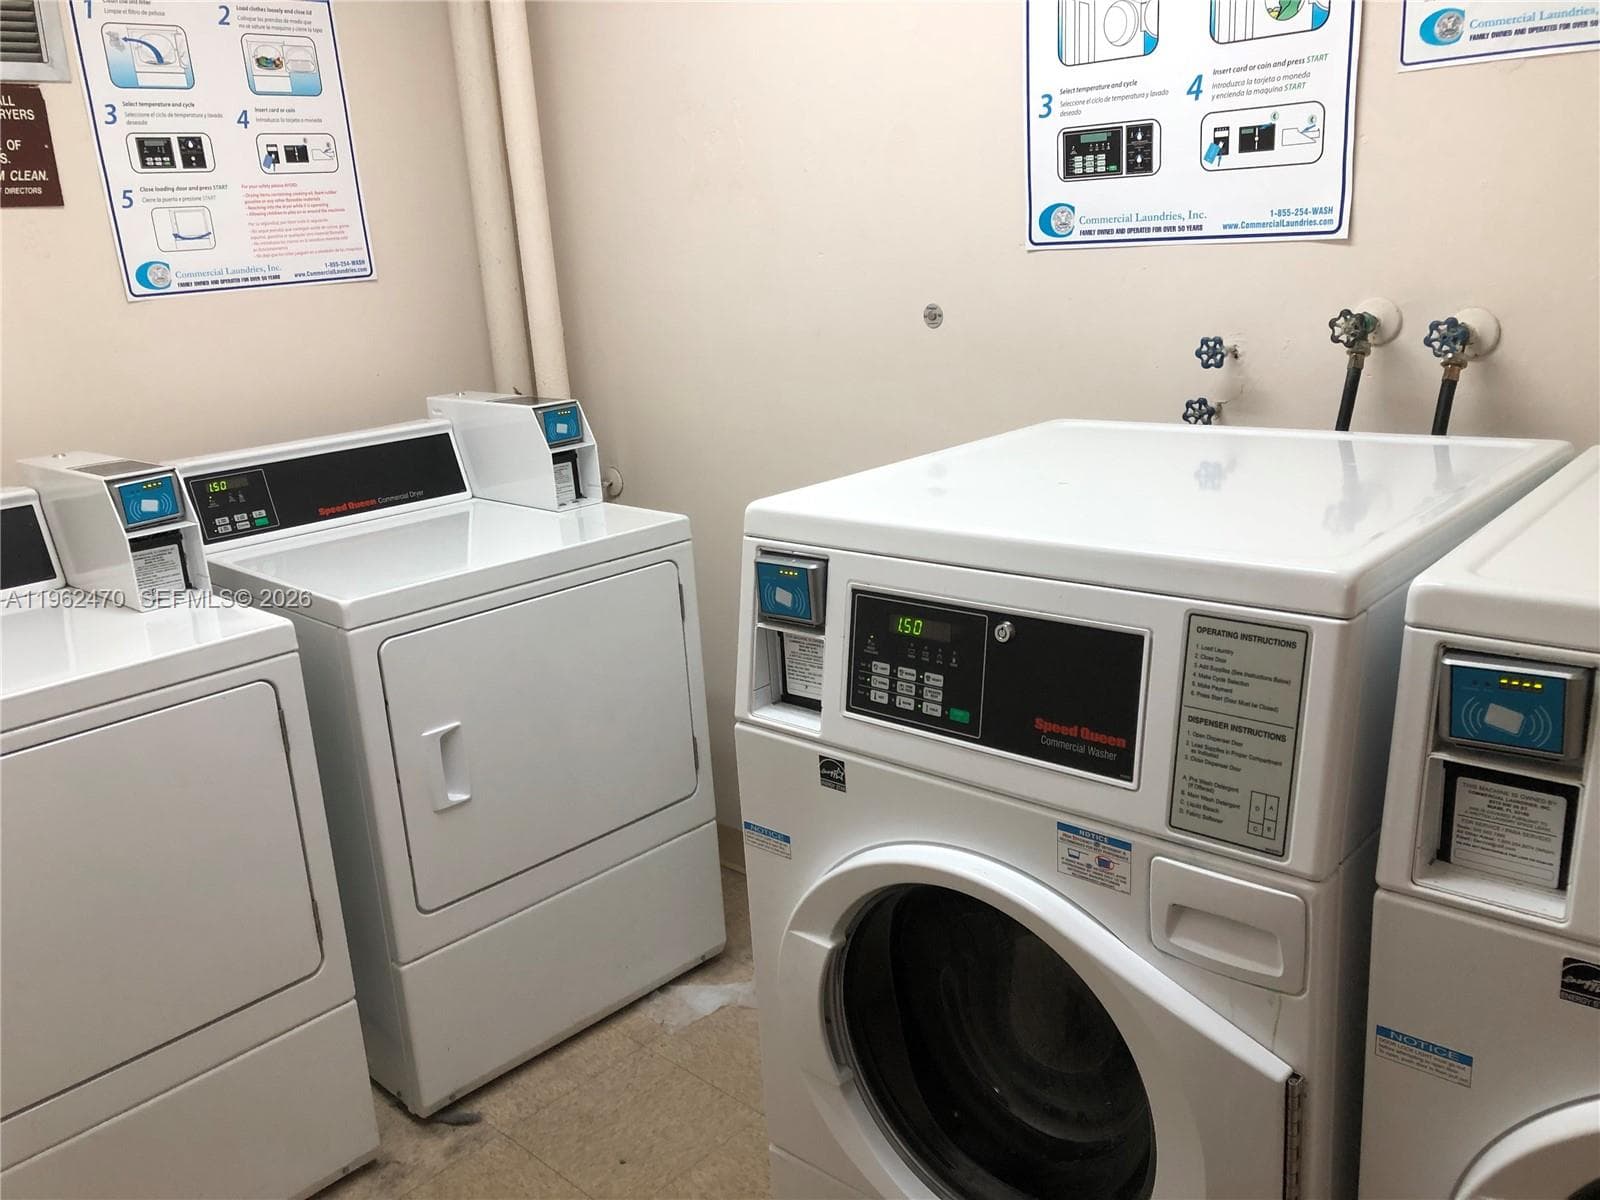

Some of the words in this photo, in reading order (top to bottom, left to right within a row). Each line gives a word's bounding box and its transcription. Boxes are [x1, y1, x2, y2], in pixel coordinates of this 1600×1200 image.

[84, 0, 92, 18] 1
[218, 5, 230, 25] 2
[1470, 12, 1535, 28] Commercial
[1540, 6, 1599, 20] Laundries,
[1470, 32, 1490, 41] FAMILY
[1492, 29, 1512, 38] OWNED
[1514, 28, 1526, 36] AND
[1528, 24, 1557, 34] OPERATED
[1559, 23, 1570, 31] FOR
[1572, 21, 1588, 29] OVER
[1213, 66, 1231, 76] Insert
[1233, 64, 1248, 73] card
[1257, 61, 1272, 70] coin
[1273, 59, 1286, 68] and
[1287, 58, 1305, 68] press
[1306, 53, 1328, 63] START
[1060, 87, 1075, 95] Select
[1076, 84, 1110, 94] temperature
[1111, 81, 1122, 89] and
[1123, 80, 1137, 89] cycle
[1186, 74, 1203, 100] 4
[1212, 80, 1245, 90] Introduzca
[1254, 75, 1275, 85] tarjeta
[1282, 71, 1310, 81] moneda
[1216, 88, 1244, 98] encienda
[1246, 87, 1252, 95] la
[1254, 85, 1283, 95] maquina
[1284, 81, 1306, 91] START
[139, 101, 170, 109] temperature
[1038, 94, 1053, 118] 3
[1060, 99, 1084, 107] Seleccione
[1092, 96, 1103, 104] ciclo
[1112, 92, 1145, 102] temperatura
[1150, 89, 1169, 97] lavado
[104, 104, 117, 124] 3
[236, 110, 250, 128] 4
[1060, 108, 1082, 117] deseado
[6, 140, 21, 150] OF
[10, 170, 48, 180] CLEAN.
[122, 190, 133, 208] 5
[1079, 214, 1132, 225] Commercial
[1136, 211, 1185, 222] Laundries,
[1188, 210, 1207, 219] Inc.
[1270, 206, 1333, 217] 1-855-254-WASH
[1080, 228, 1096, 236] FAMILY
[1127, 226, 1151, 234] OPERATED
[1163, 225, 1176, 233] OVER
[1187, 224, 1203, 232] YEARS
[1222, 218, 1334, 230] www.CommercialLaundries.com
[176, 267, 223, 278] Commercial
[226, 266, 266, 275] Laundries,
[318, 504, 347, 516] Speed
[348, 499, 377, 509] Queen
[378, 492, 408, 503] Commercial
[409, 490, 424, 498] Dryer
[1196, 626, 1238, 639] OPERATING
[1240, 633, 1297, 649] INSTRUCTIONS
[1034, 718, 1078, 737] Speed
[1080, 727, 1126, 748] Queen
[1188, 715, 1229, 730] DISPENSER
[1230, 724, 1287, 742] INSTRUCTIONS
[1041, 734, 1085, 754] Commercial
[1087, 744, 1117, 761] Washer
[1079, 830, 1108, 843] NOTICE
[1390, 1032, 1459, 1060] NOTICE
